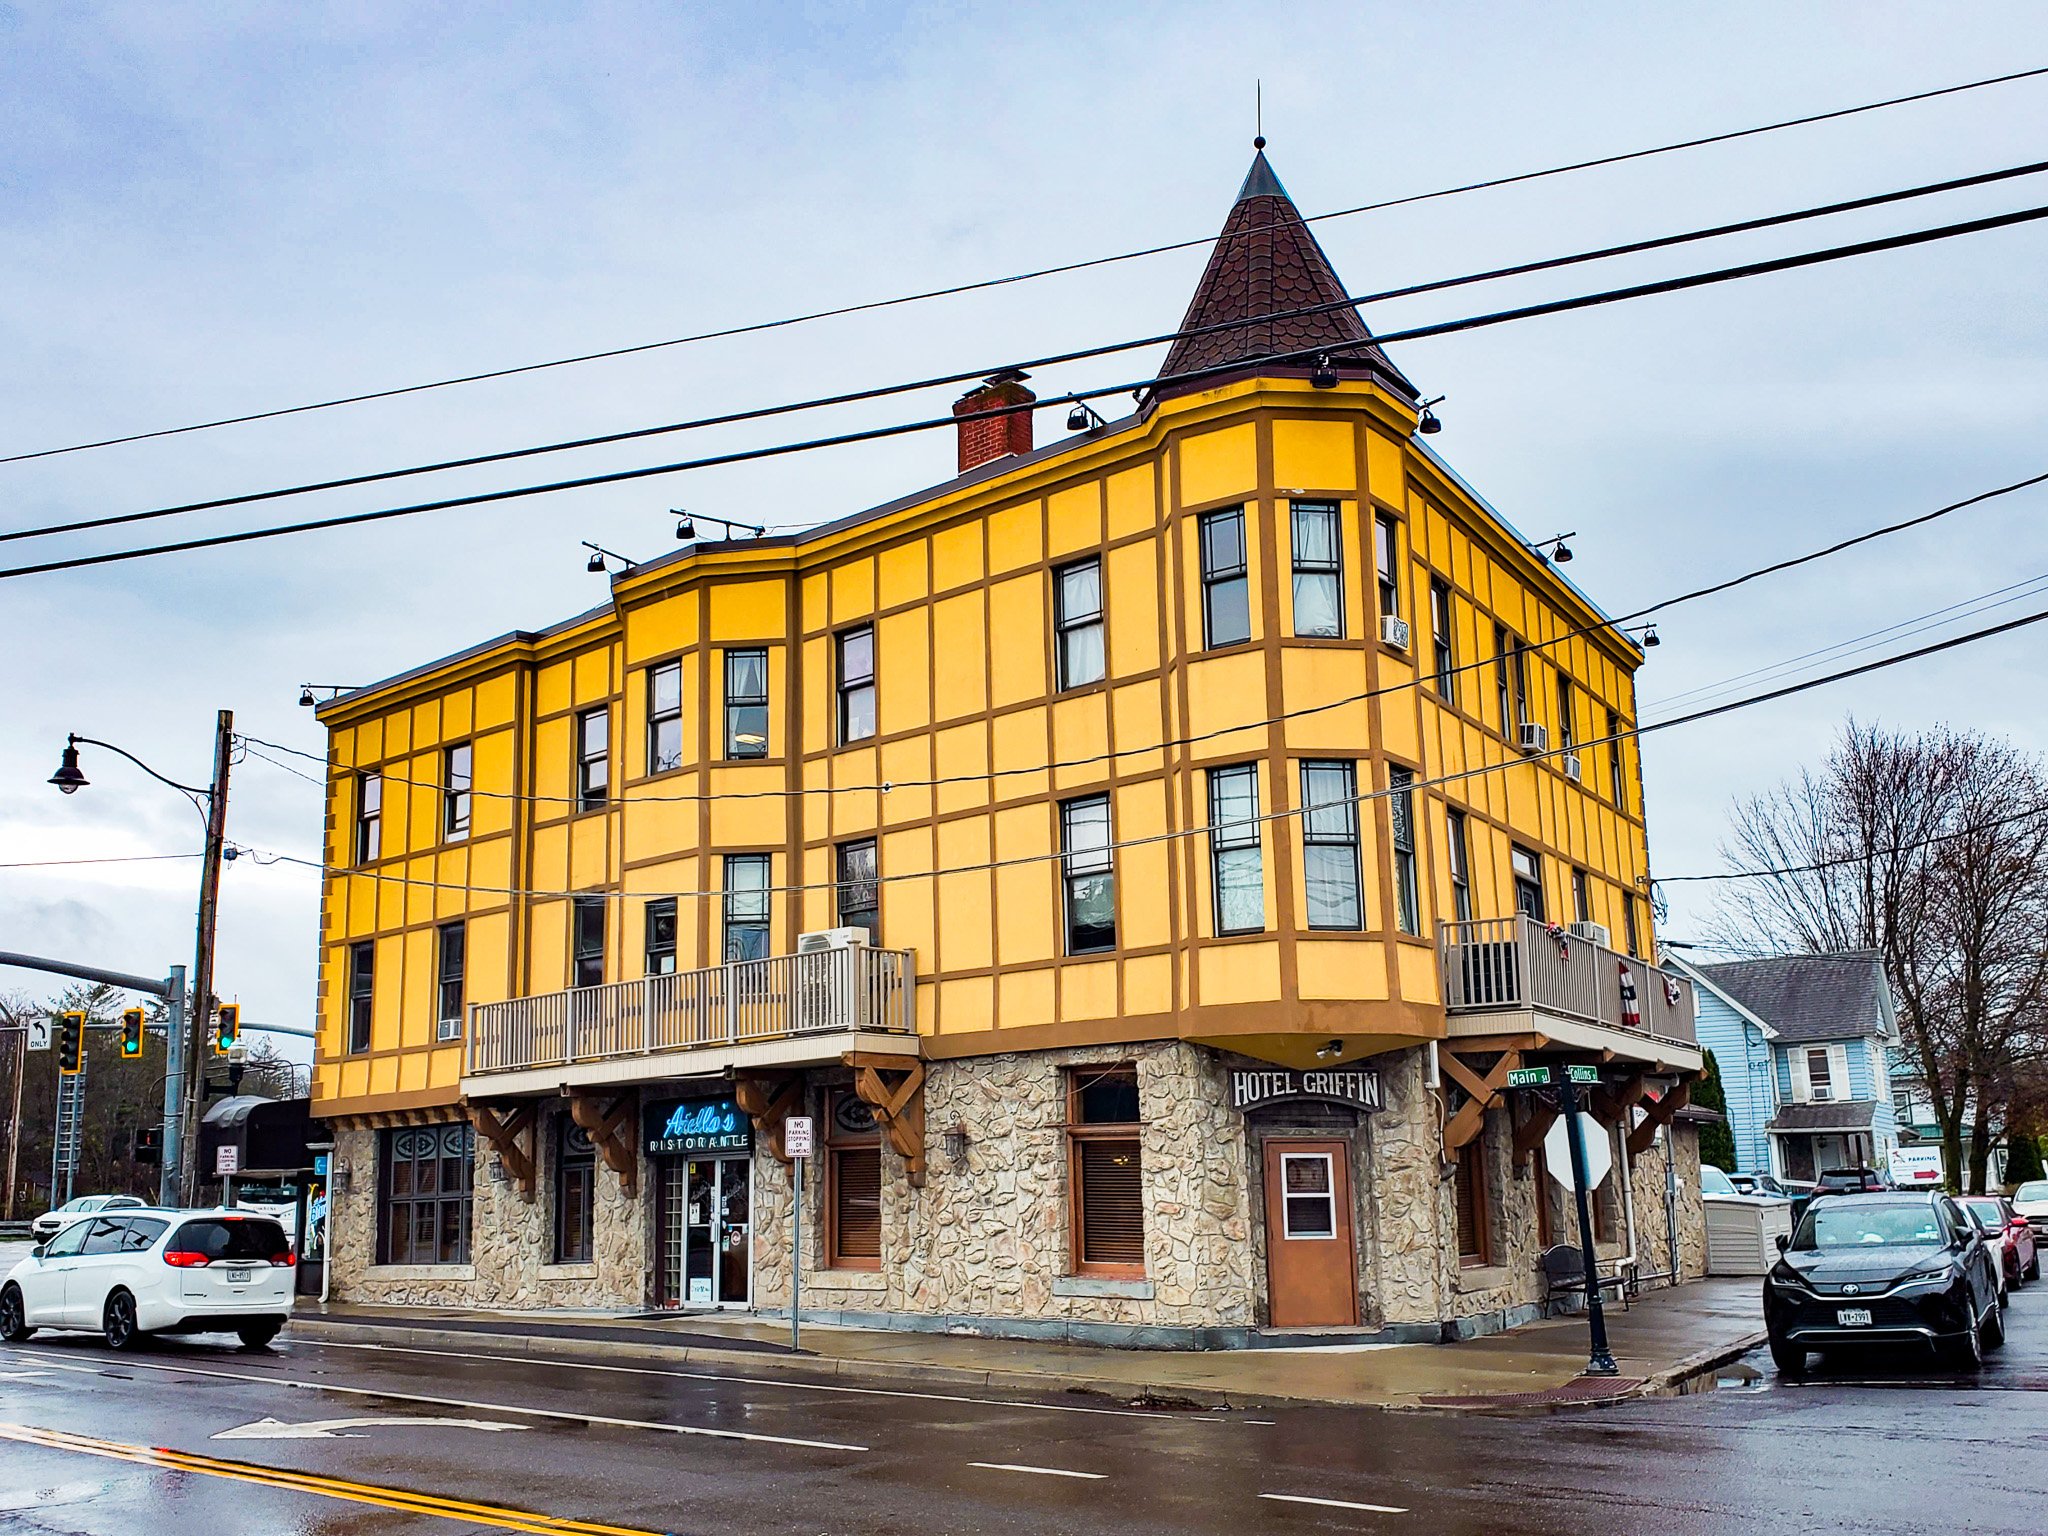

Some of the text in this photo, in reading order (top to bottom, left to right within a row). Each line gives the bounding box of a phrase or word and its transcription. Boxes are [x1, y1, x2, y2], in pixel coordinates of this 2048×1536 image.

[1509, 1070, 1537, 1085] Main
[1570, 1067, 1592, 1081] Collins
[1233, 1072, 1379, 1107] HOTEL GRIFFIN
[663, 1102, 736, 1138] Aiello's
[794, 1120, 804, 1129] NO
[650, 1134, 748, 1152] RISTORANTE
